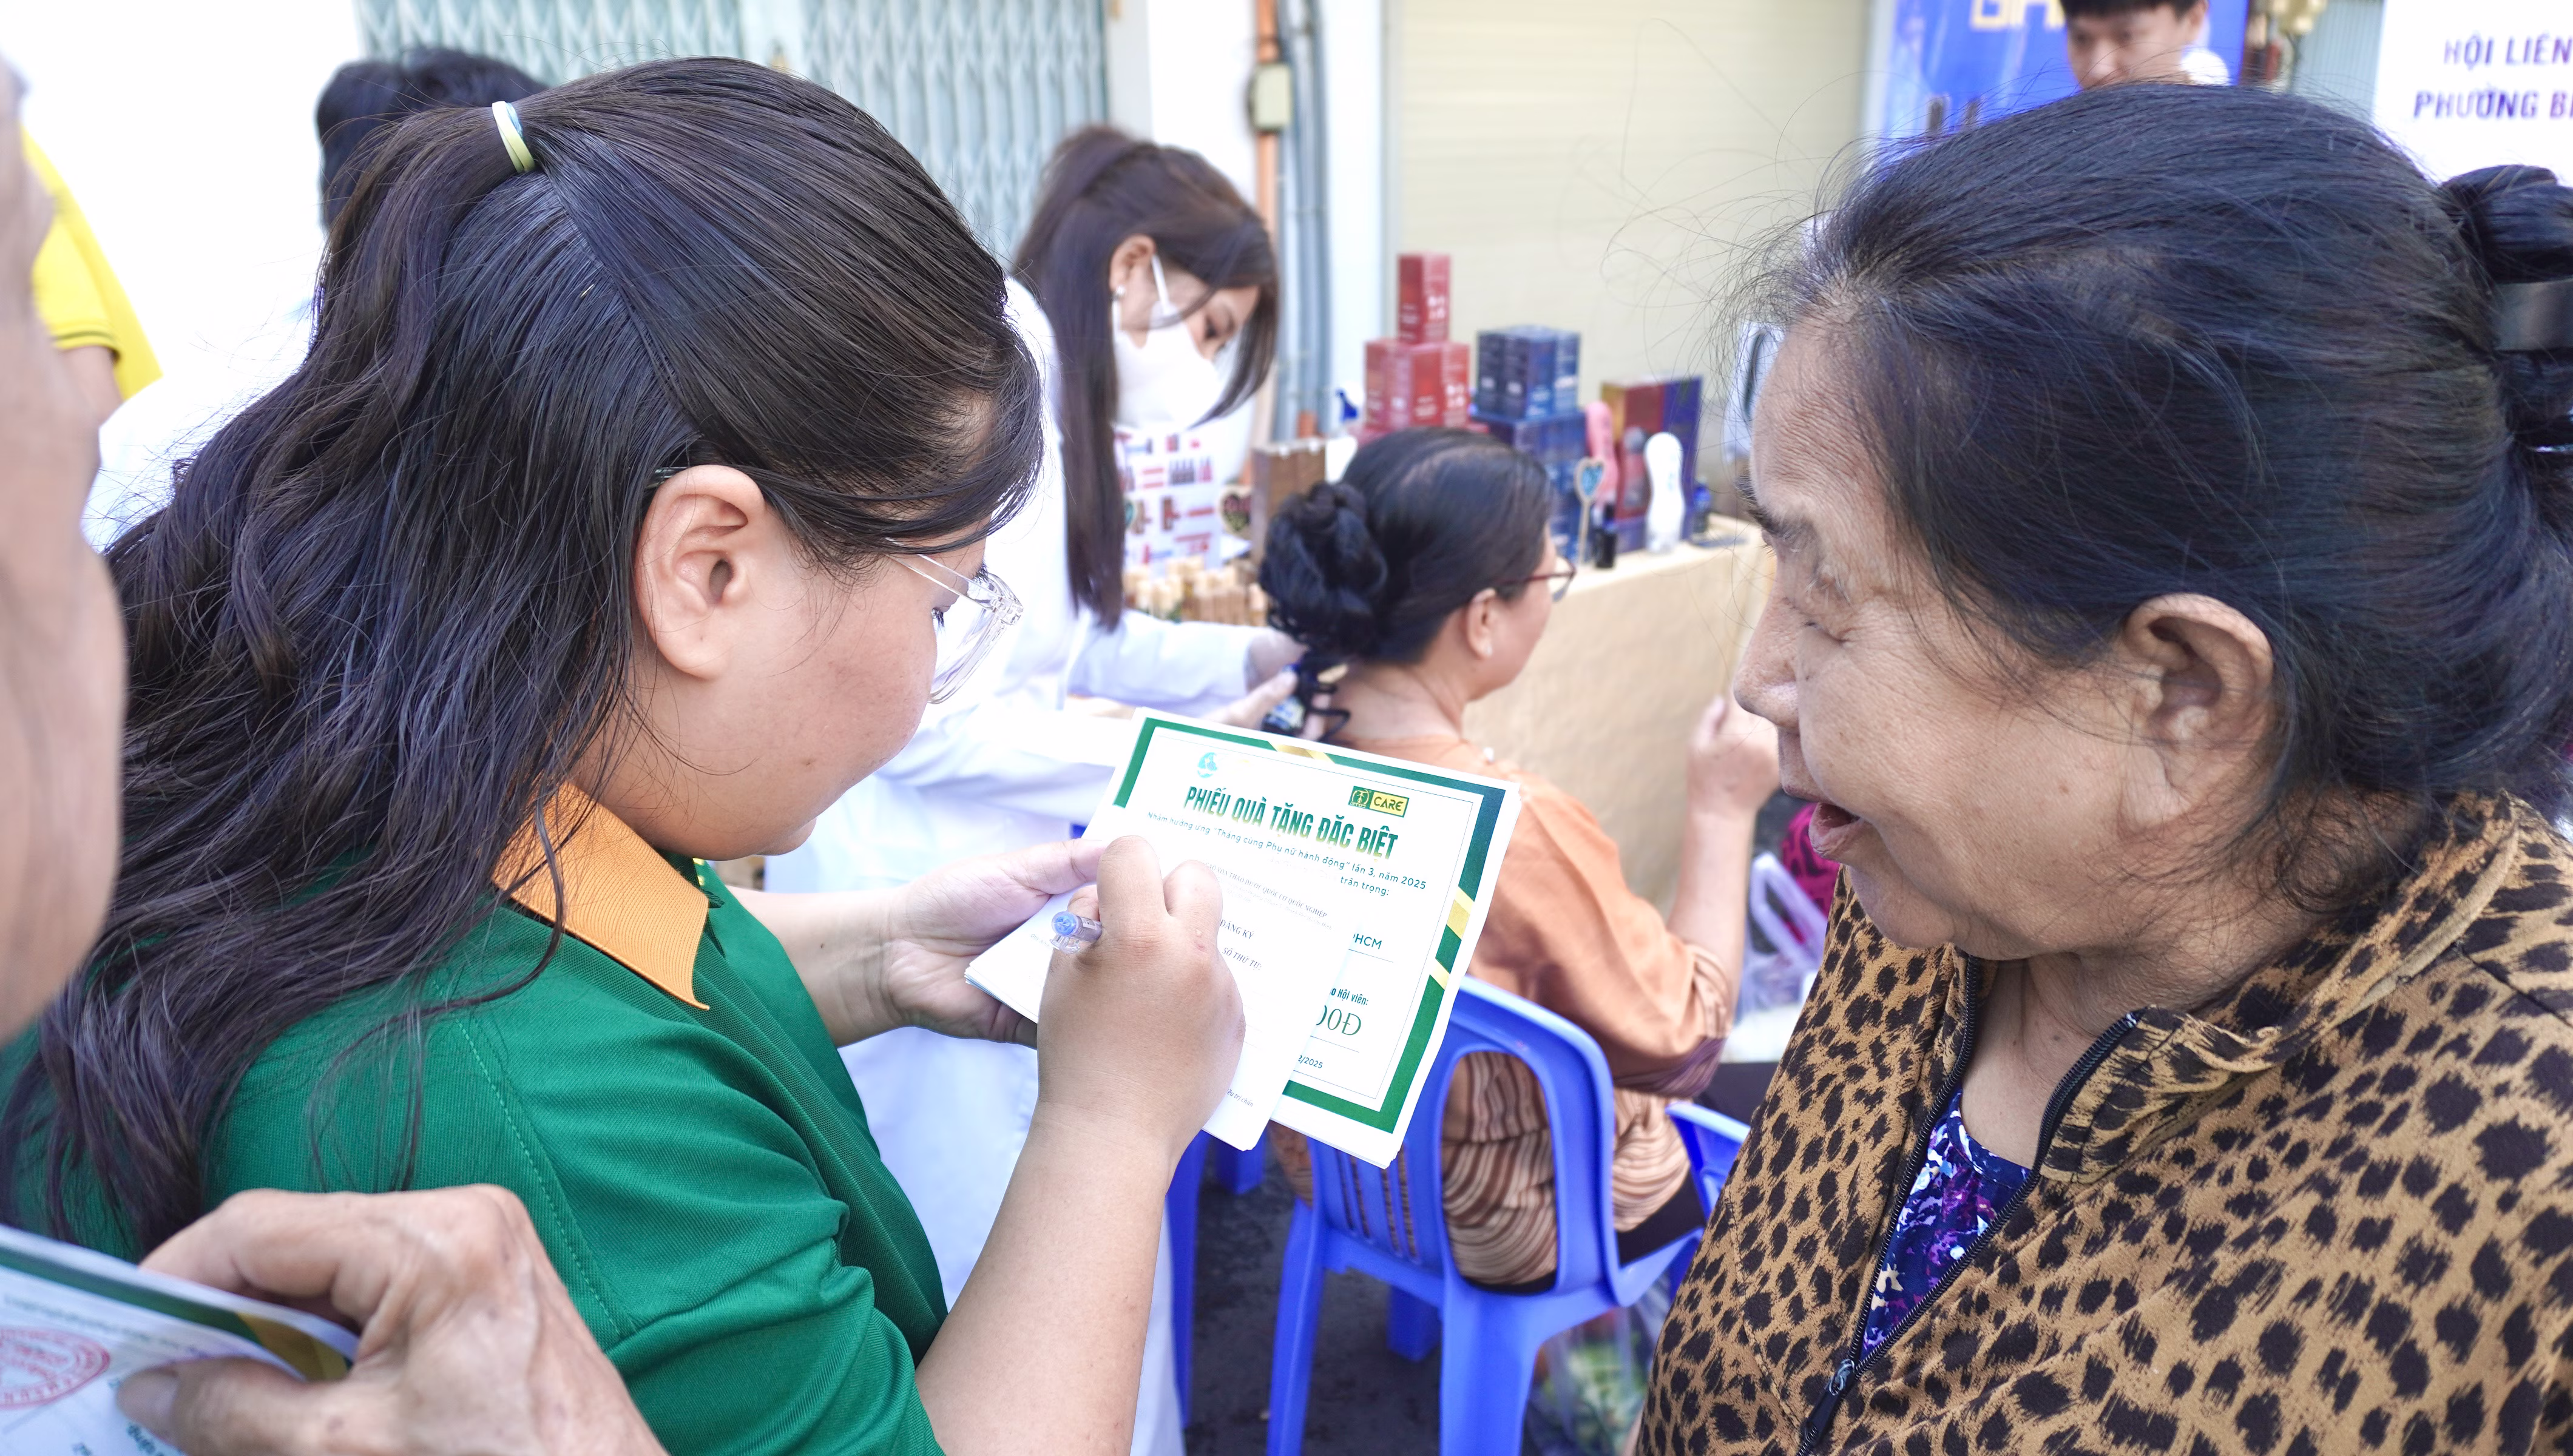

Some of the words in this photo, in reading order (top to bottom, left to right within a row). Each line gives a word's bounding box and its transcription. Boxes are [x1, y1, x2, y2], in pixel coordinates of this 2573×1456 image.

[2443, 30, 2495, 72] HỘI
[2505, 30, 2573, 66] LIÊN
[2413, 83, 2539, 119] PHƯỜNG
[1373, 797, 1404, 811] CARE
[1183, 786, 1231, 817] PHIẾU
[1231, 797, 1267, 828] QUÀ
[1269, 803, 1314, 839] TẶNG
[1316, 815, 1354, 851] ĐẶC
[1355, 826, 1398, 862] BIỆT
[1243, 837, 1263, 849] cùng
[1266, 841, 1282, 854] Phụ
[1285, 848, 1297, 856] nữ
[1299, 850, 1320, 862] hành
[1368, 868, 1376, 878] 3,
[1379, 872, 1398, 883] năm
[1401, 876, 1426, 889] 2025
[1341, 876, 1359, 887] trân
[1362, 881, 1390, 897] trọng:
[1220, 919, 1242, 935] ĐĂNG
[1337, 989, 1350, 1001] Hội
[1351, 993, 1369, 1006] viên:
